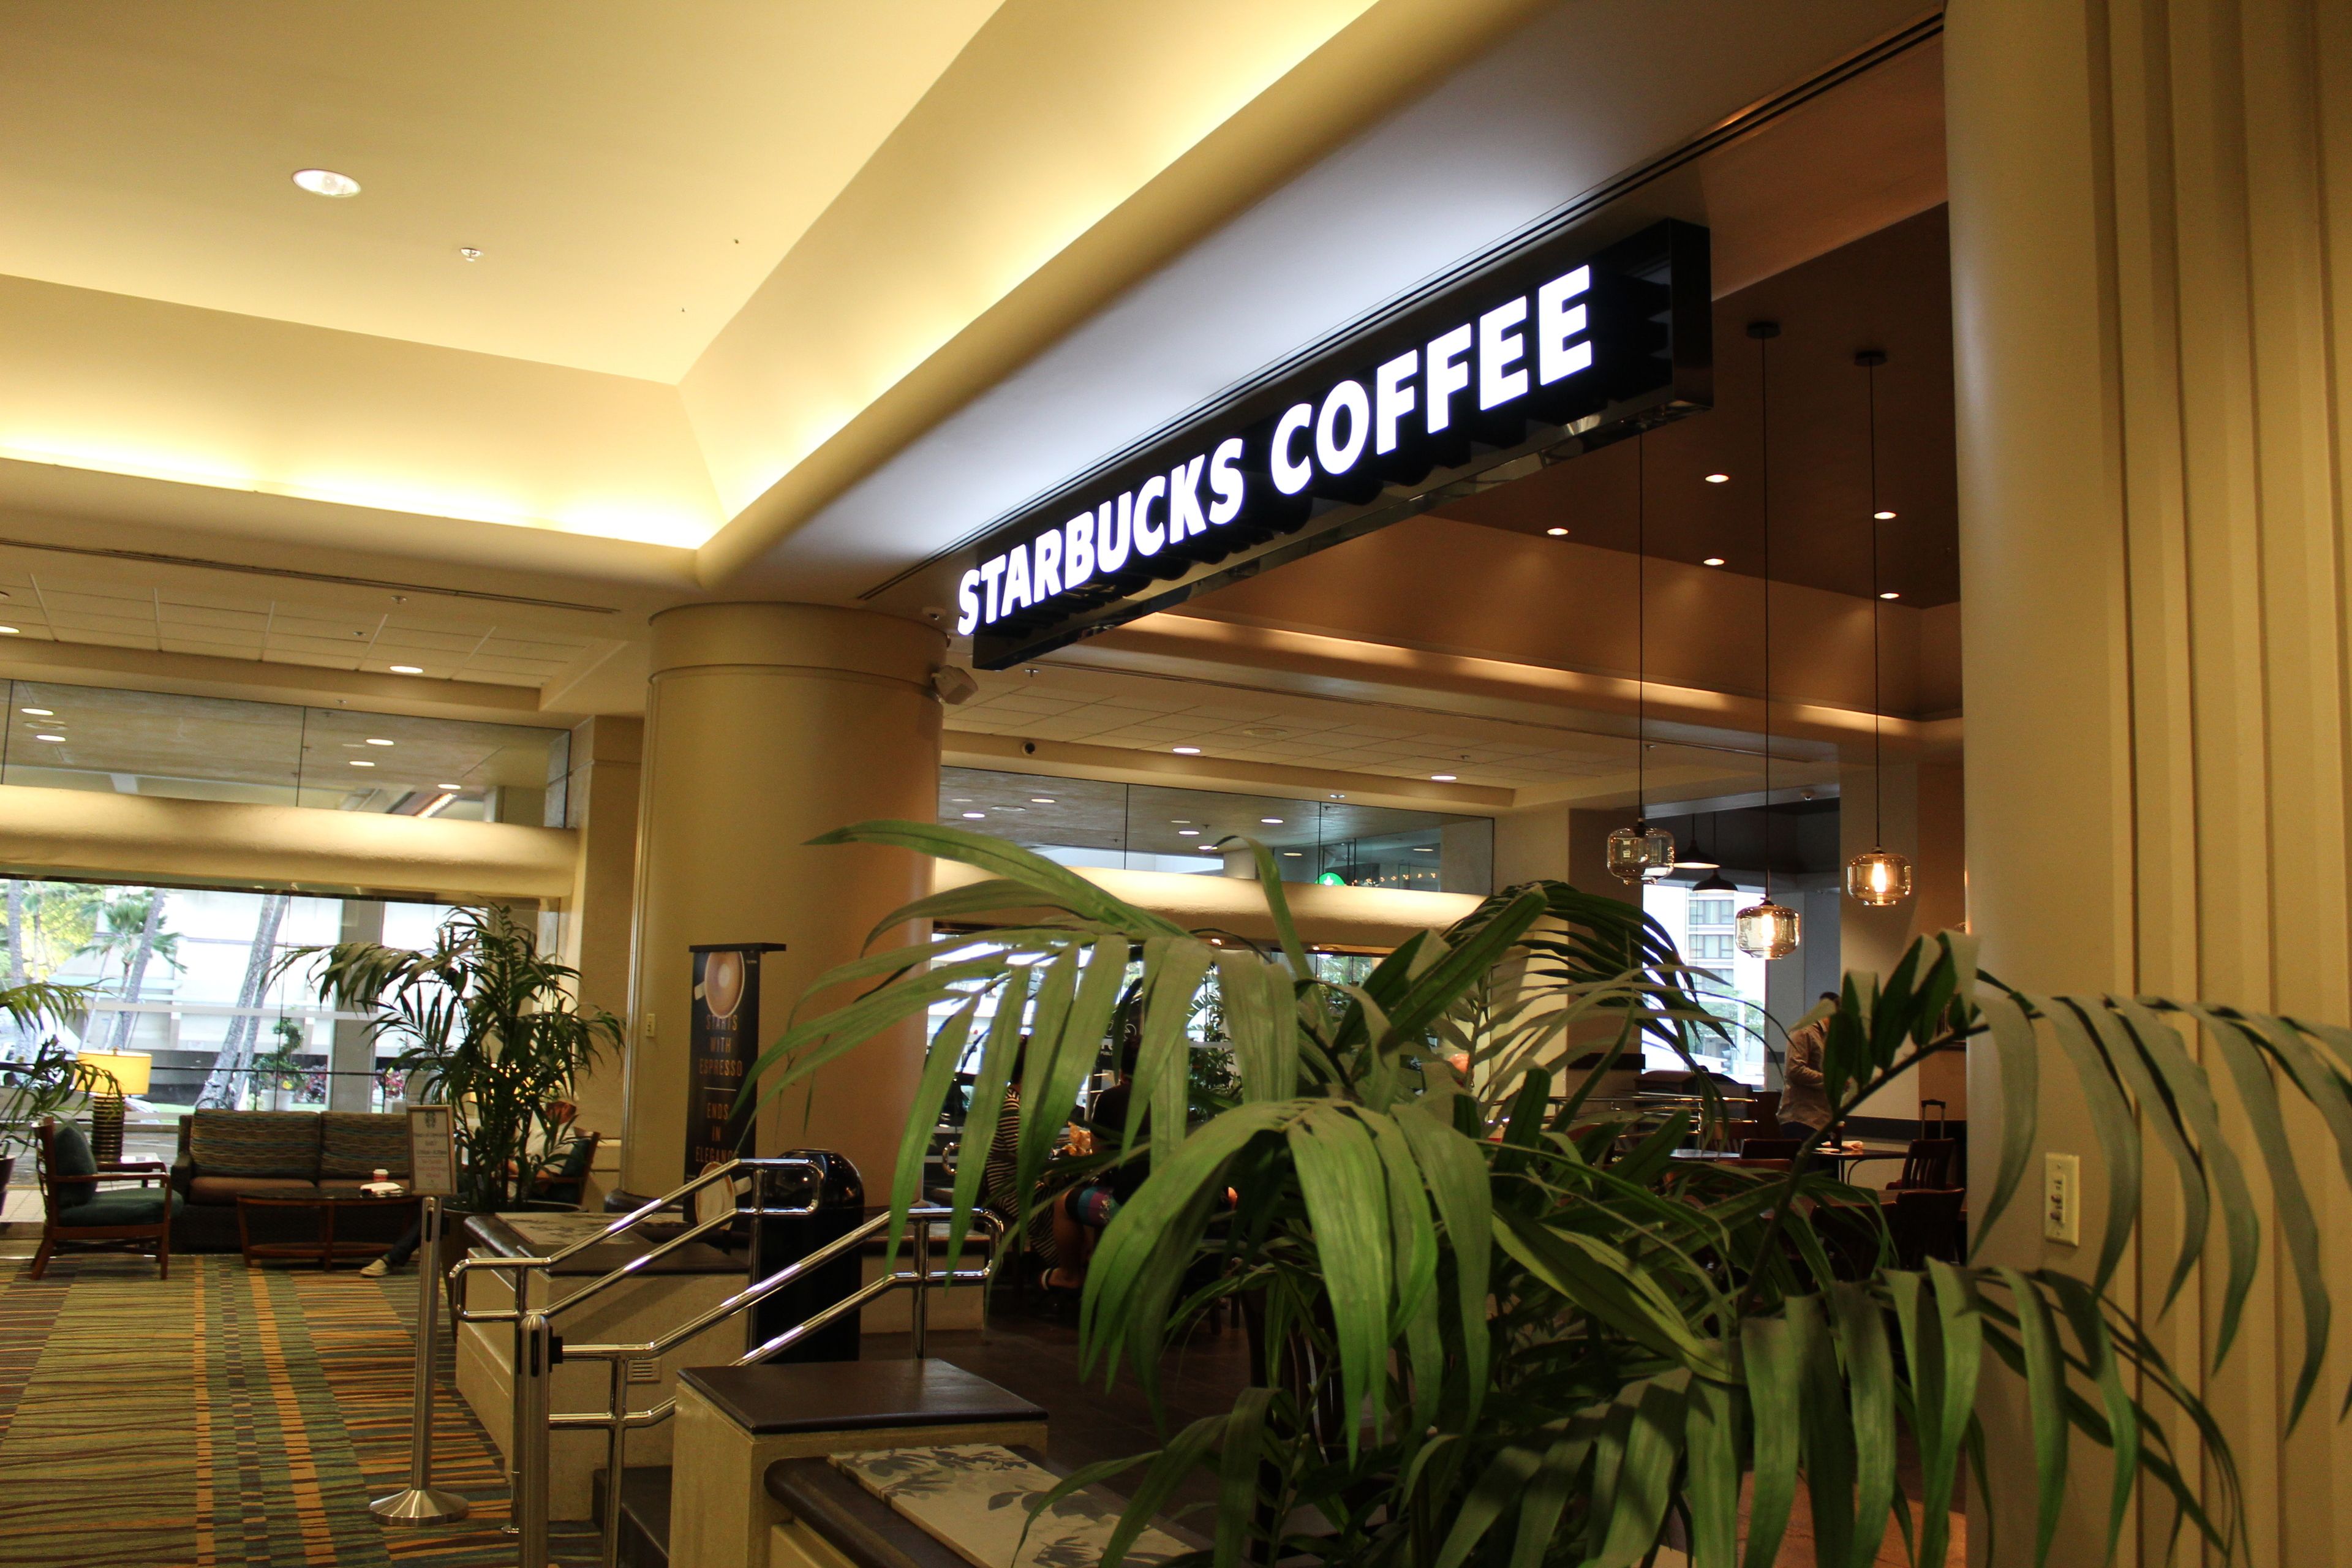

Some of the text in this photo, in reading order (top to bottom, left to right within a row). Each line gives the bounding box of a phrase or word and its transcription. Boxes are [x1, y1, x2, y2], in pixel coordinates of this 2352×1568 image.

[957, 265, 1593, 636] STARBUCKS COFFEE
[710, 1036, 731, 1052] WITH
[699, 1058, 742, 1076] ESPRESSO
[707, 1102, 729, 1120] ENDS
[712, 1126, 721, 1142] IN
